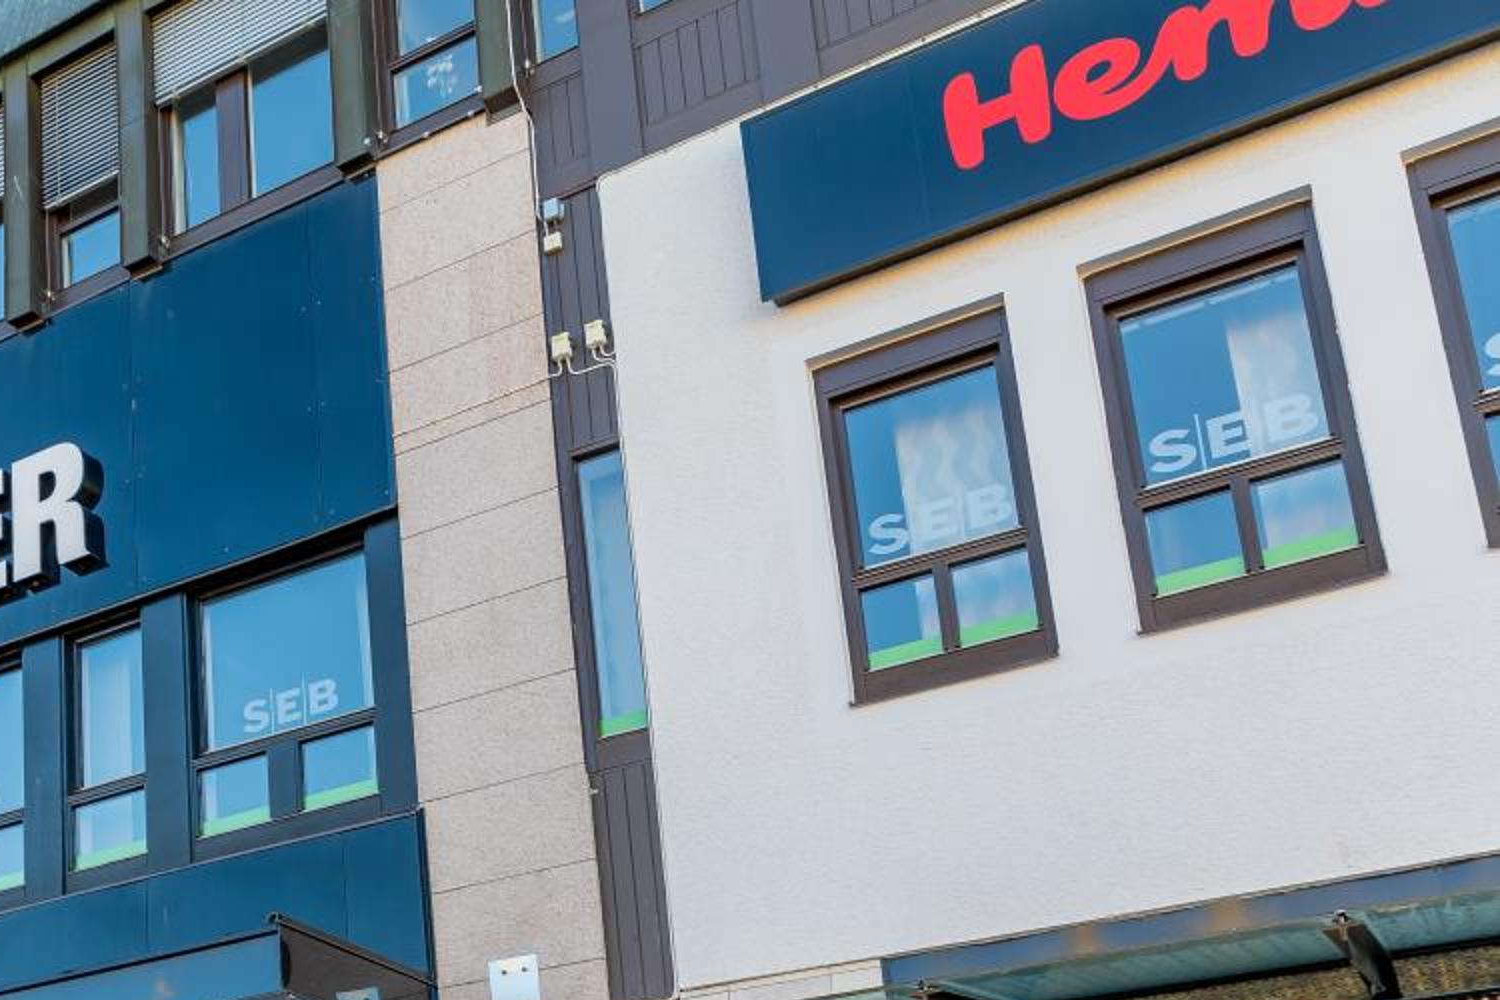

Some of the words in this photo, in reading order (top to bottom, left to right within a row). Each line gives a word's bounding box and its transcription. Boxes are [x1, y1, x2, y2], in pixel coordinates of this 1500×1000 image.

[943, 0, 1372, 170] Hem
[1149, 395, 1318, 474] SEB
[867, 484, 1013, 555] SEB
[244, 678, 338, 733] SEB
